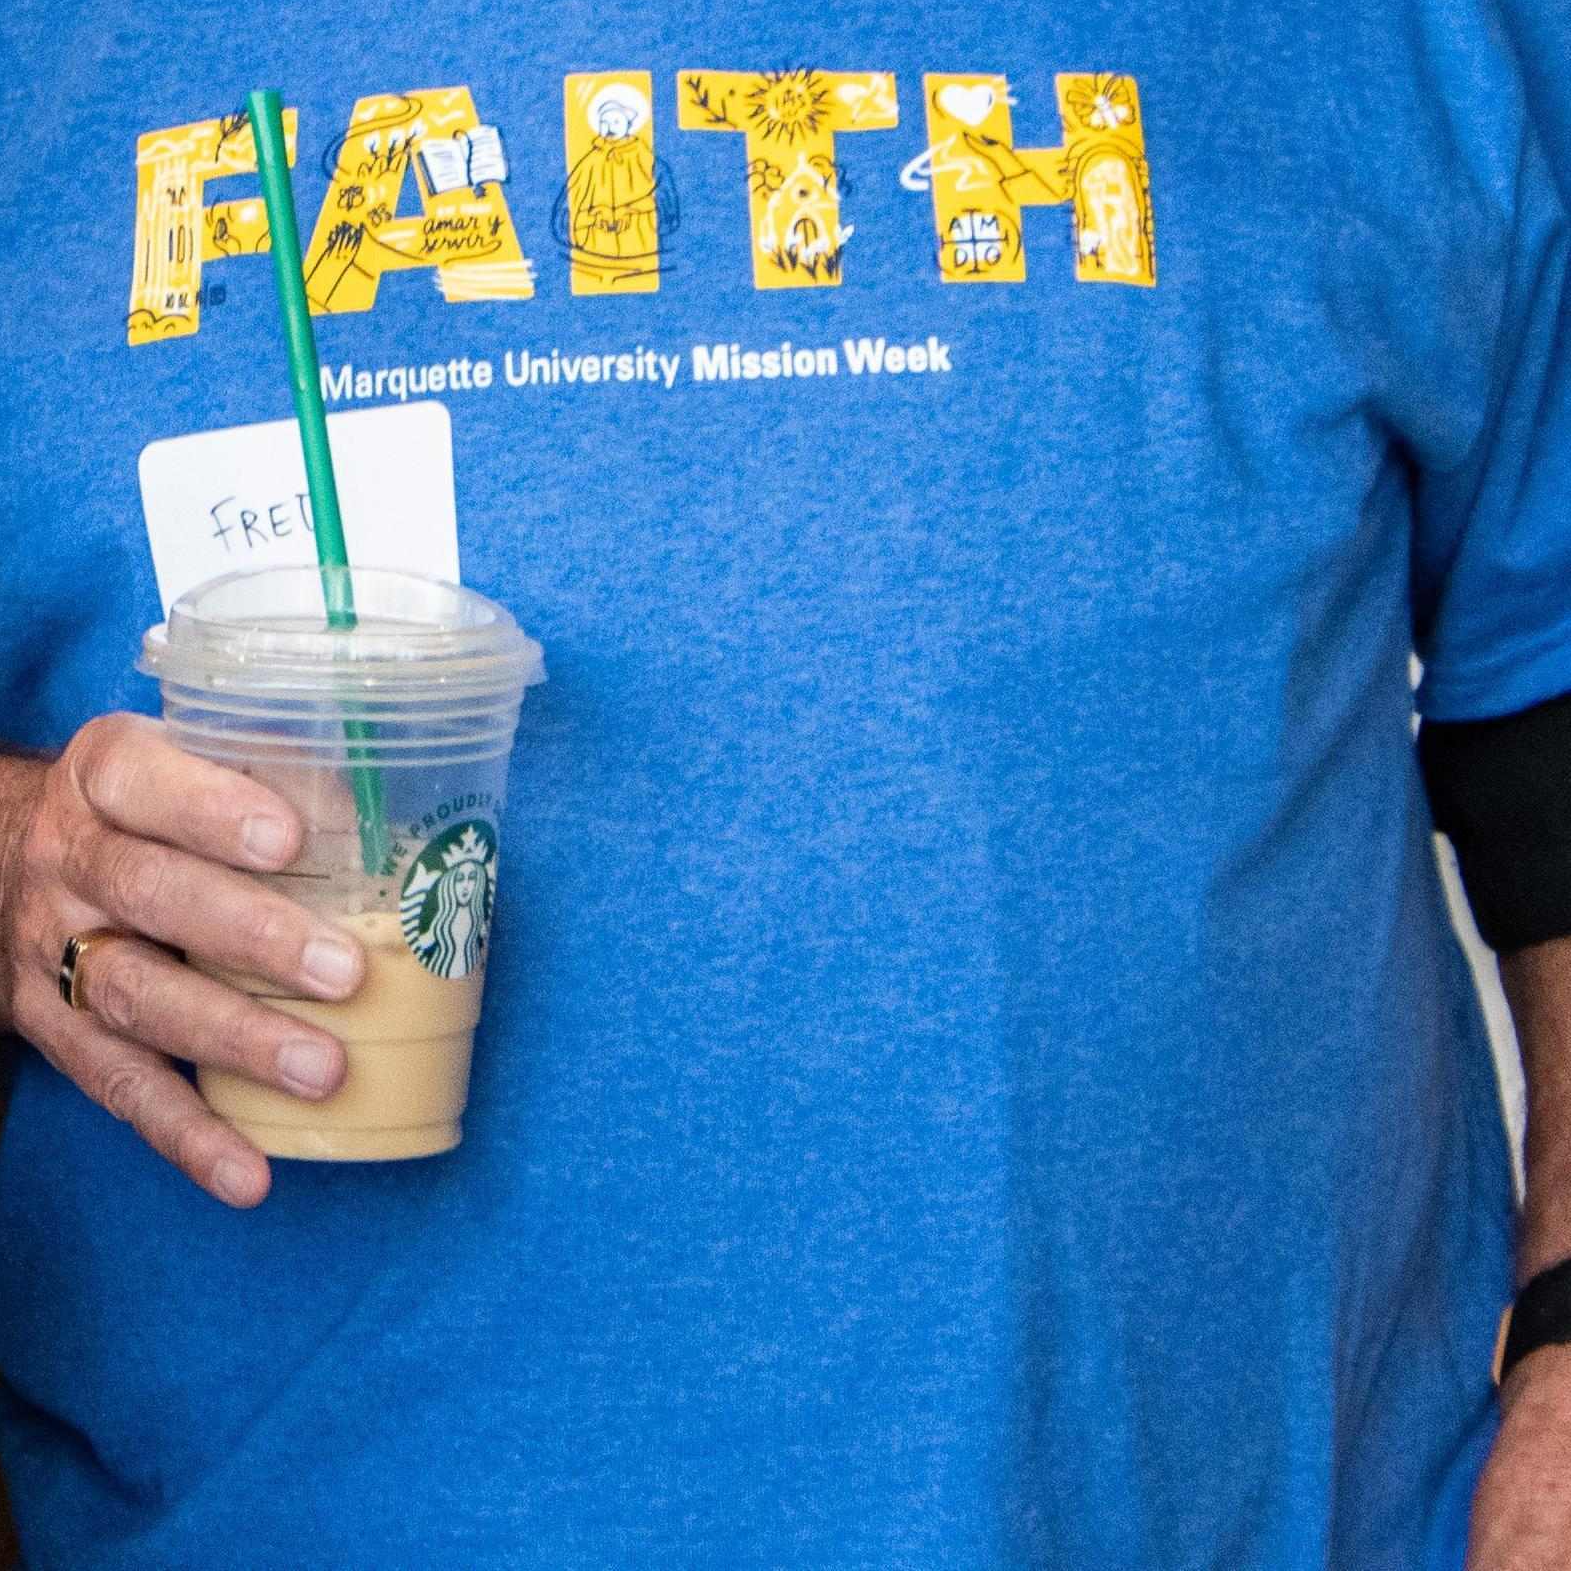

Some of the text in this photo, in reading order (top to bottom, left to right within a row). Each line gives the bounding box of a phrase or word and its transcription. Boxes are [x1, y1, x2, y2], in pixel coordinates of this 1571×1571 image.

[128, 70, 1156, 346] FAITH
[321, 336, 953, 401] Marquette University Mission Week
